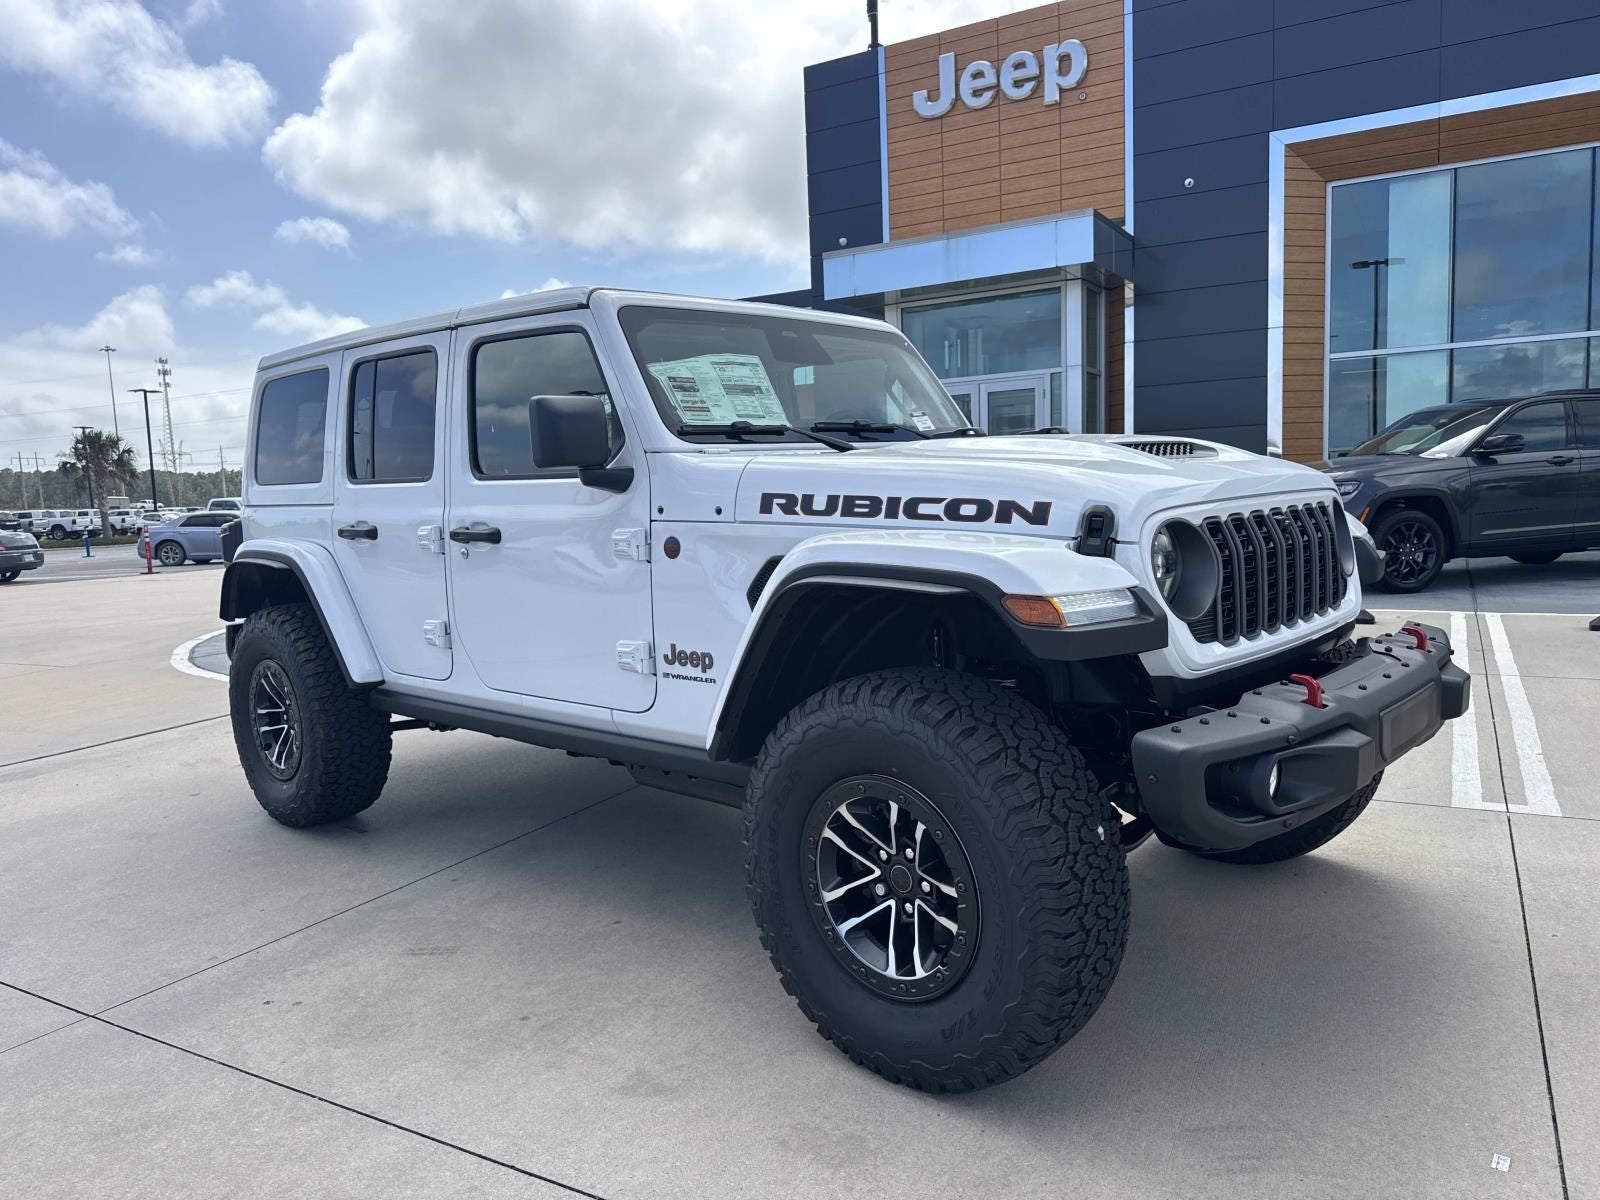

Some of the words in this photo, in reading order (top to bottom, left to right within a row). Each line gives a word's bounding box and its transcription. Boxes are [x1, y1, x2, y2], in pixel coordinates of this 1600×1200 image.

[913, 38, 1088, 119] Jeep
[759, 492, 1053, 526] RUBICON
[663, 643, 714, 674] Jeep
[670, 673, 716, 684] WRANGLER
